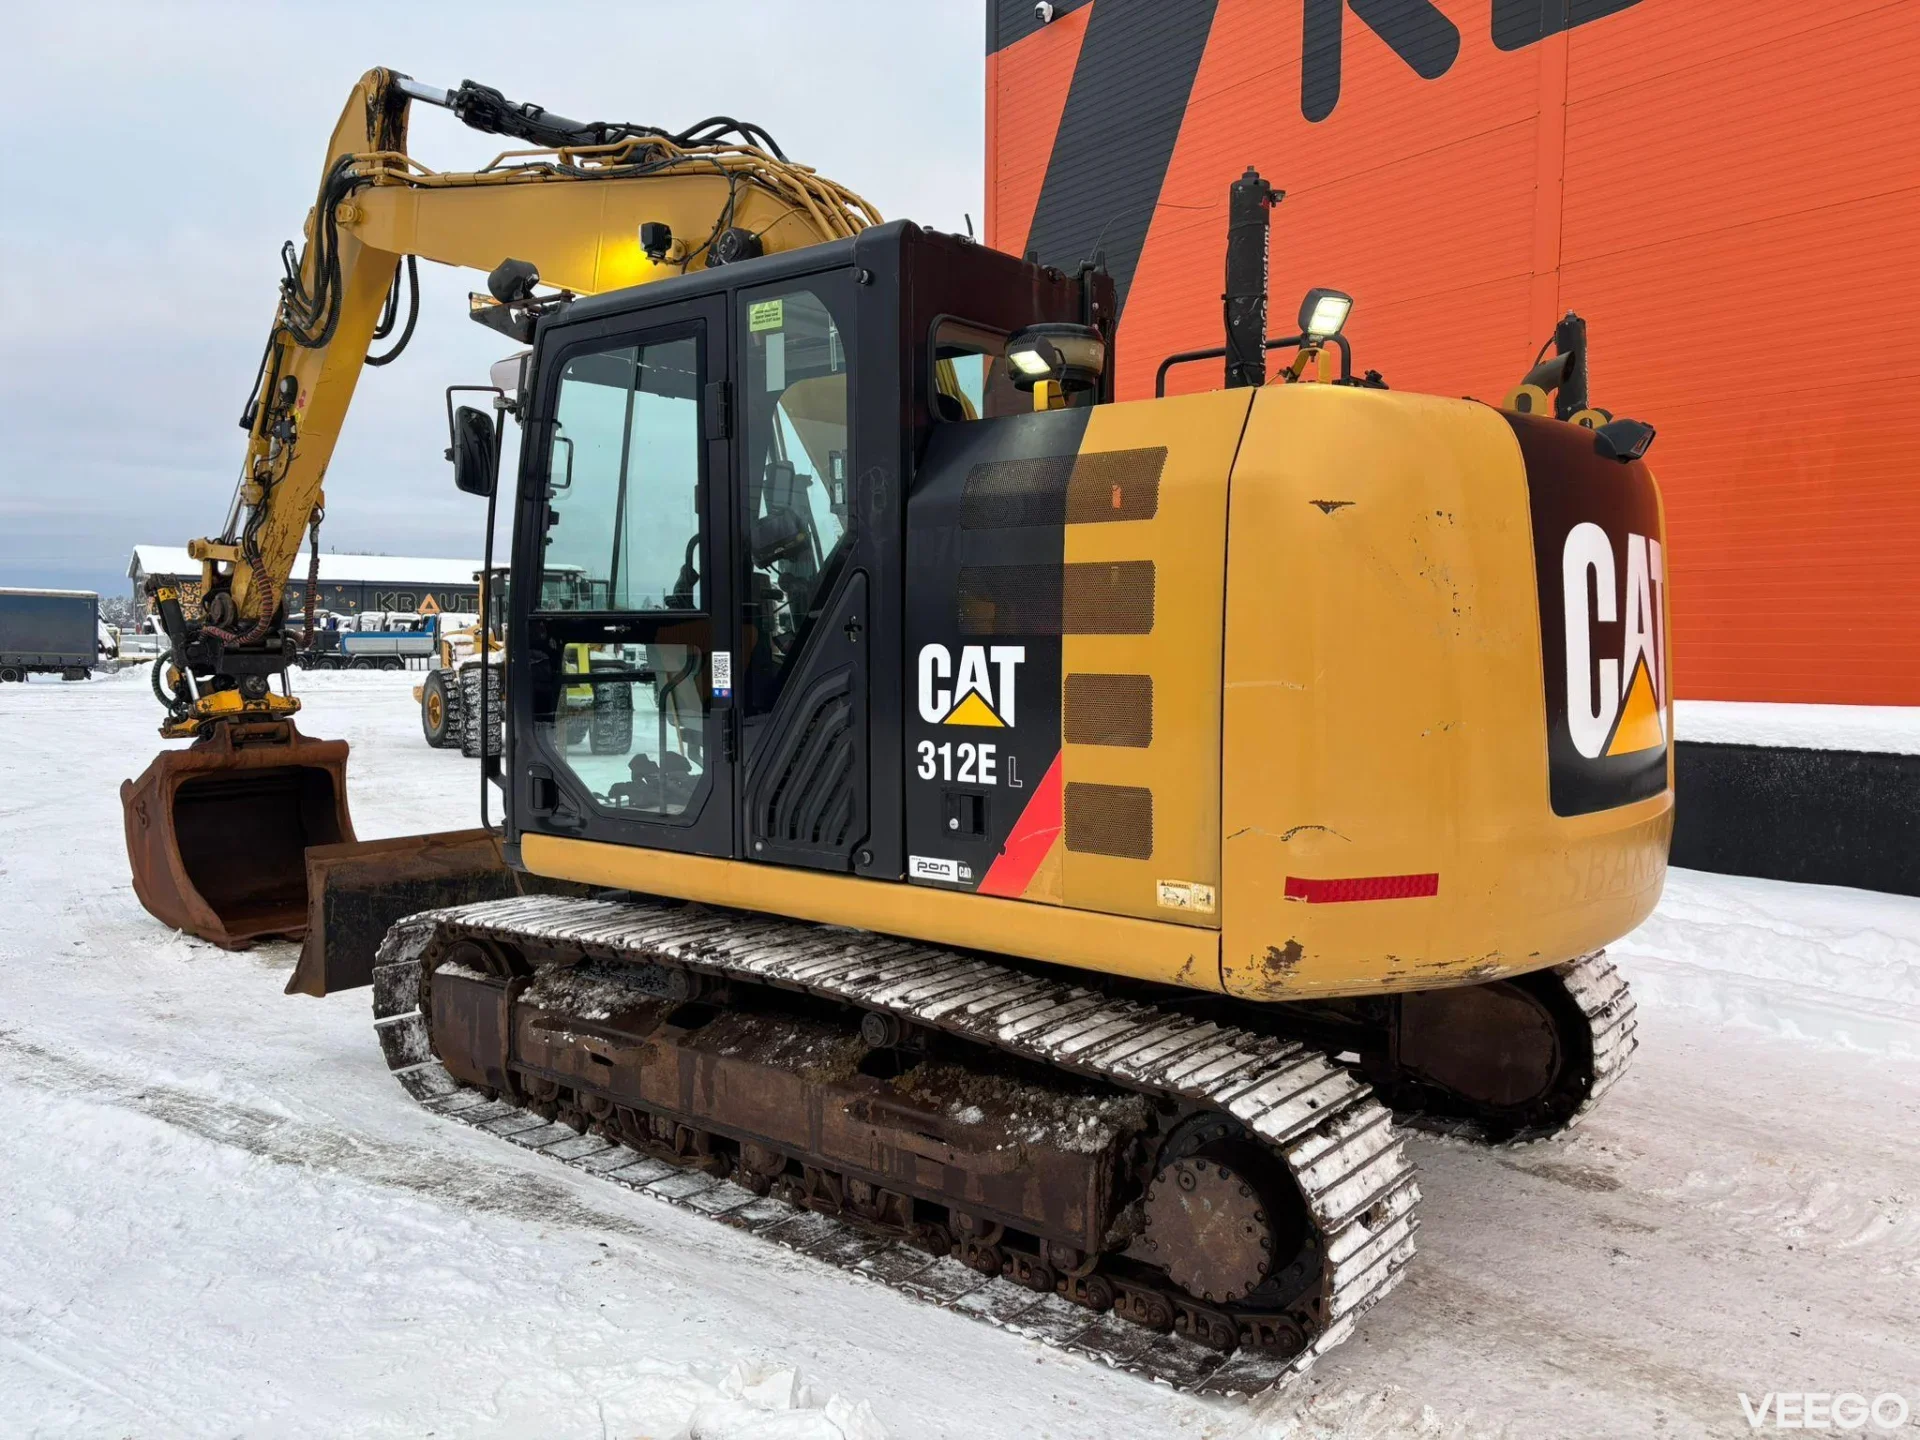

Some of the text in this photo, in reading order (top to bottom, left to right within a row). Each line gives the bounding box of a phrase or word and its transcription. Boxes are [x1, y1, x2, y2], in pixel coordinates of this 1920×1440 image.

[1562, 522, 1667, 758] CAT
[918, 643, 1025, 728] CAT
[917, 740, 1023, 788] 312E L
[917, 862, 950, 872] pon
[959, 866, 972, 879] CAT
